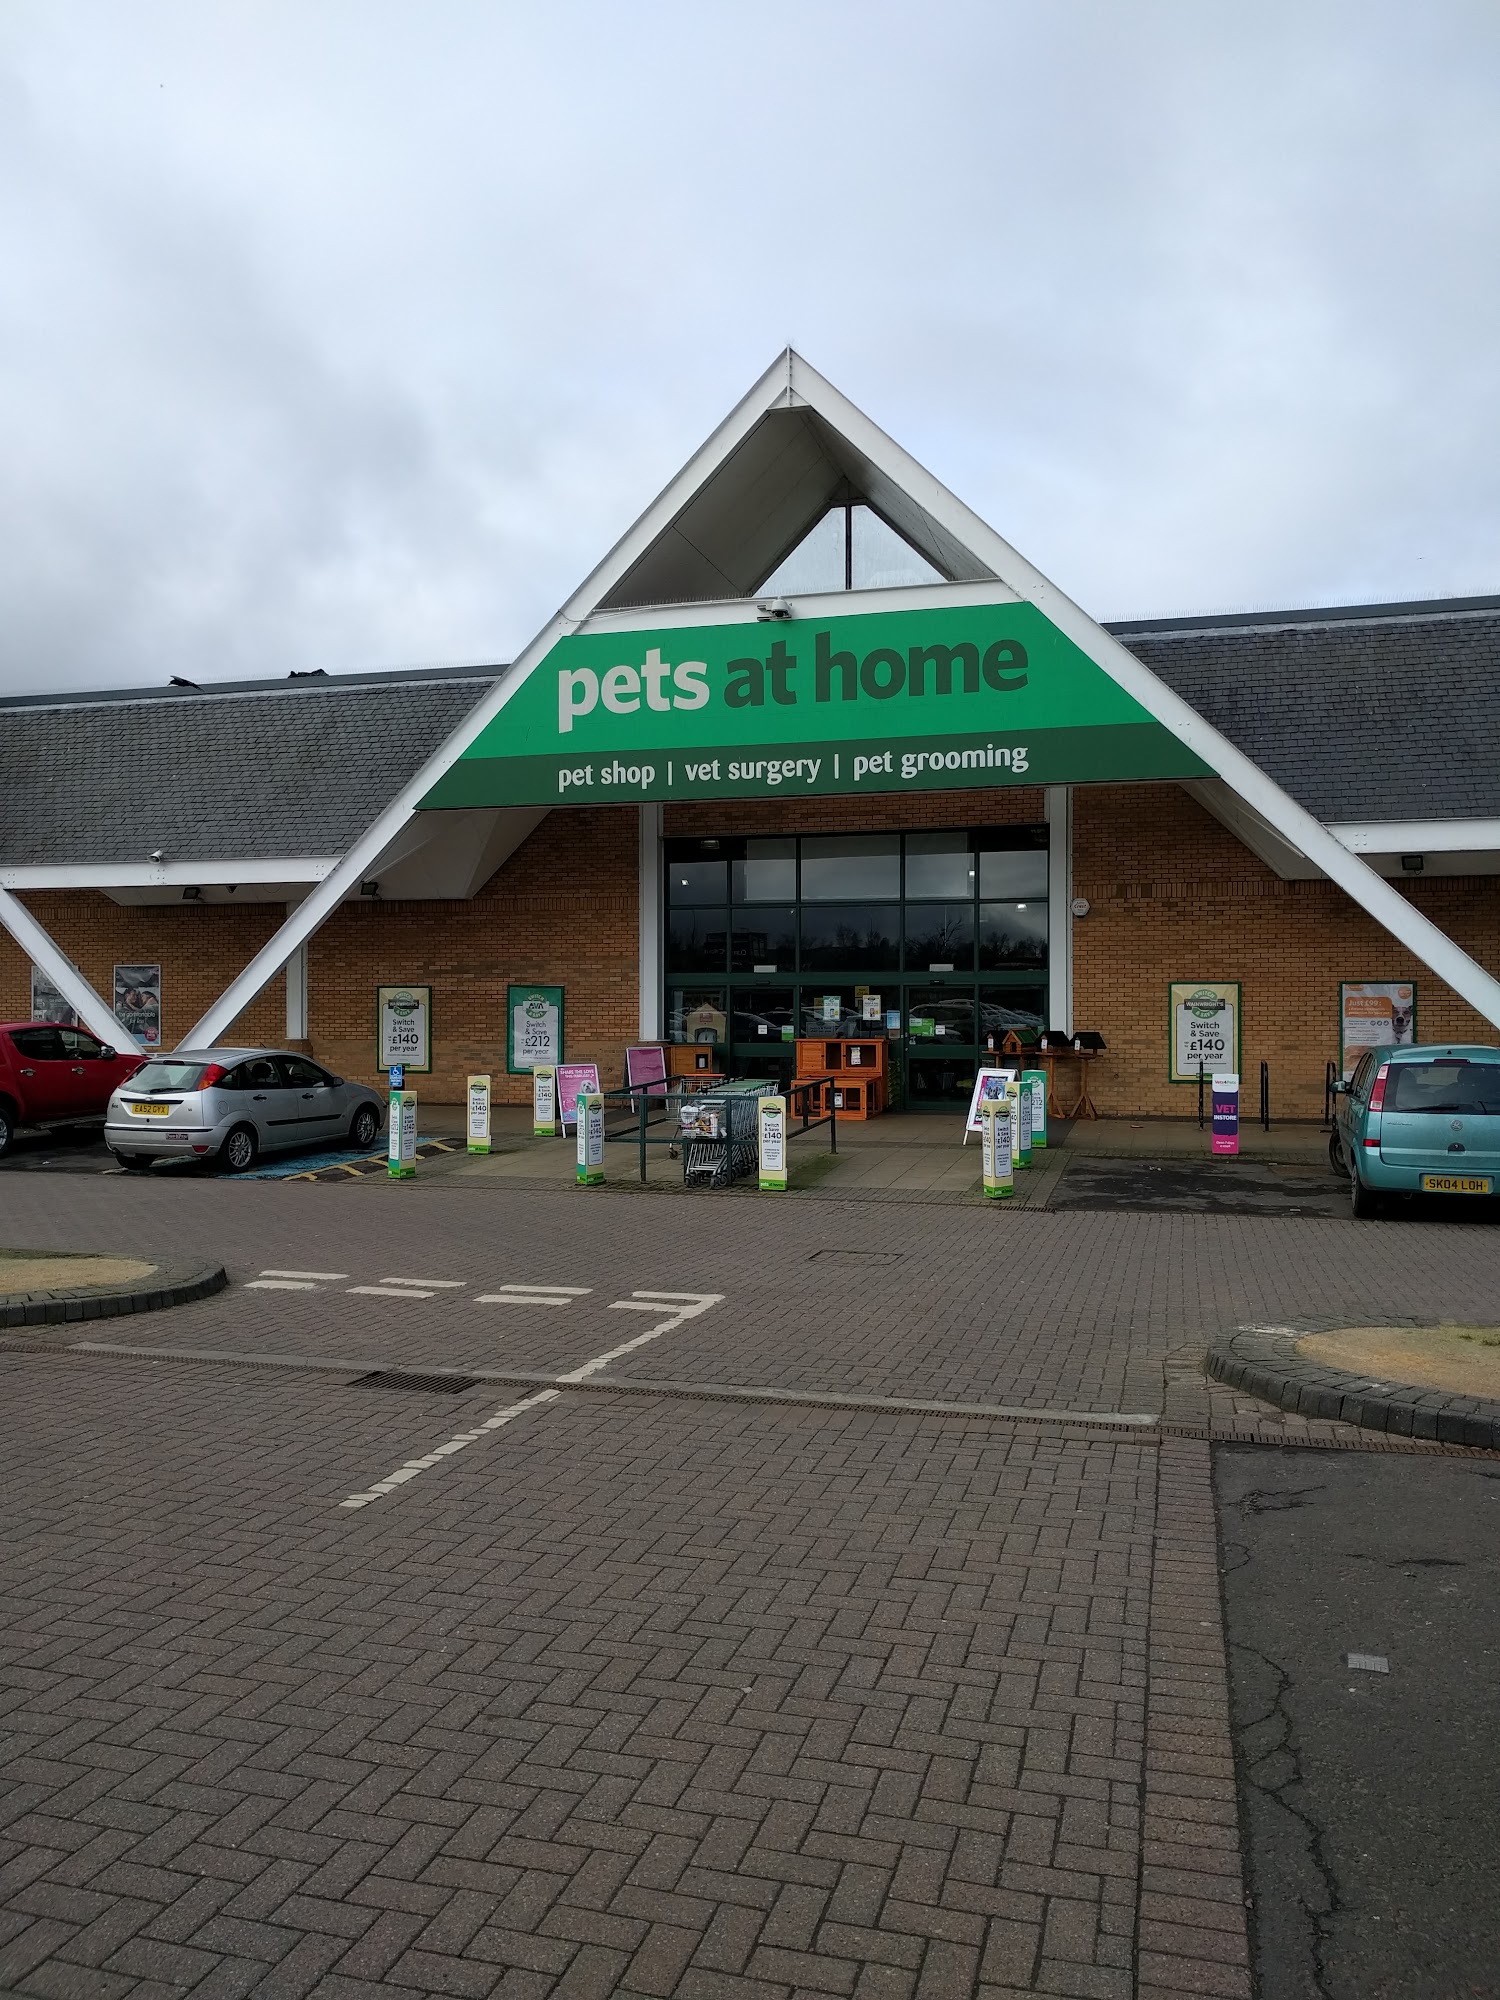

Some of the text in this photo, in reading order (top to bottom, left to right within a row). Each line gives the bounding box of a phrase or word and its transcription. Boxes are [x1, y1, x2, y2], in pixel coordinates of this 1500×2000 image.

[558, 631, 1029, 734] pets at home
[558, 764, 594, 793] pet
[600, 760, 656, 790] shop
[685, 759, 721, 781] vet
[728, 758, 822, 785] surgery
[853, 751, 894, 781] pet
[900, 743, 1029, 779] grooming
[1194, 991, 1216, 999] SWITCH
[392, 1034, 419, 1044] £140
[525, 1036, 550, 1046] £212
[1190, 1039, 1224, 1050] £140
[1216, 1105, 1236, 1113] VET
[1429, 1179, 1483, 1190] SK04 LOH
